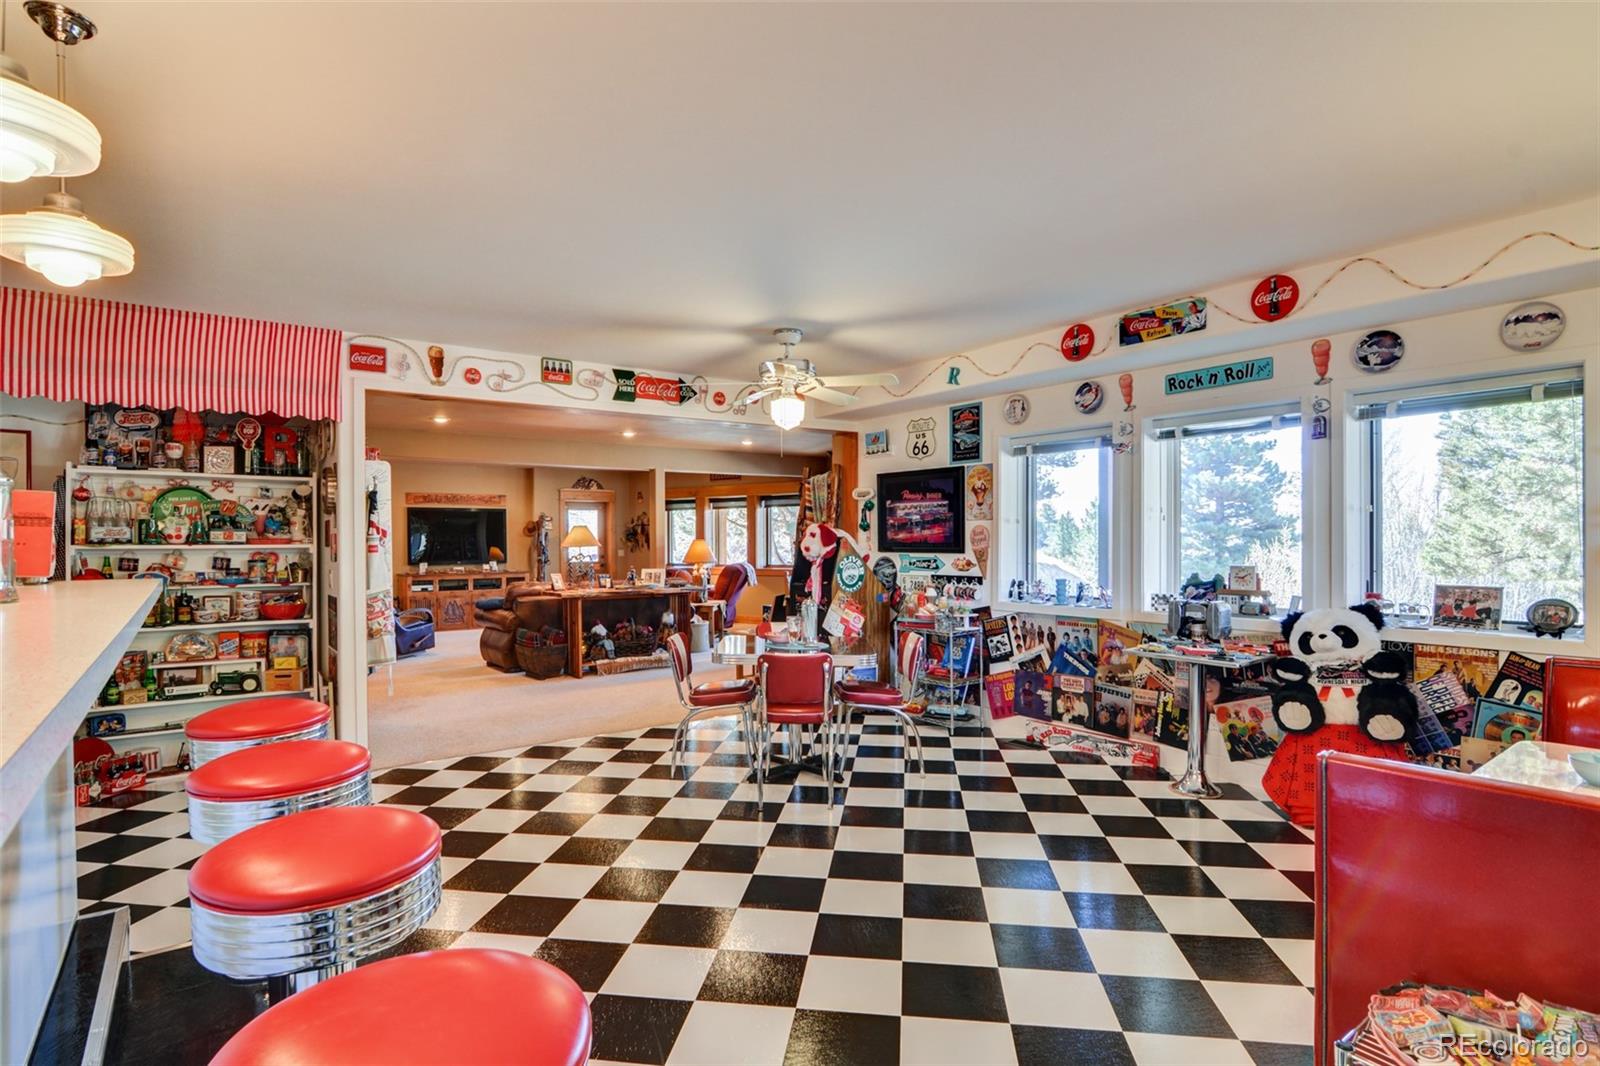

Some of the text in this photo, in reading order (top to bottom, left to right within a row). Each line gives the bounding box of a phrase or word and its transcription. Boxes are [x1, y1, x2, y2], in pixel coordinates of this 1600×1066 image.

[1255, 286, 1293, 306] Coca-Cola
[618, 378, 636, 386] SOLD
[946, 366, 961, 386] R
[1168, 373, 1204, 392] Rock
[1224, 362, 1255, 382] Roll
[264, 425, 298, 465] R
[912, 440, 929, 456] 66
[1387, 642, 1413, 651] LOVE
